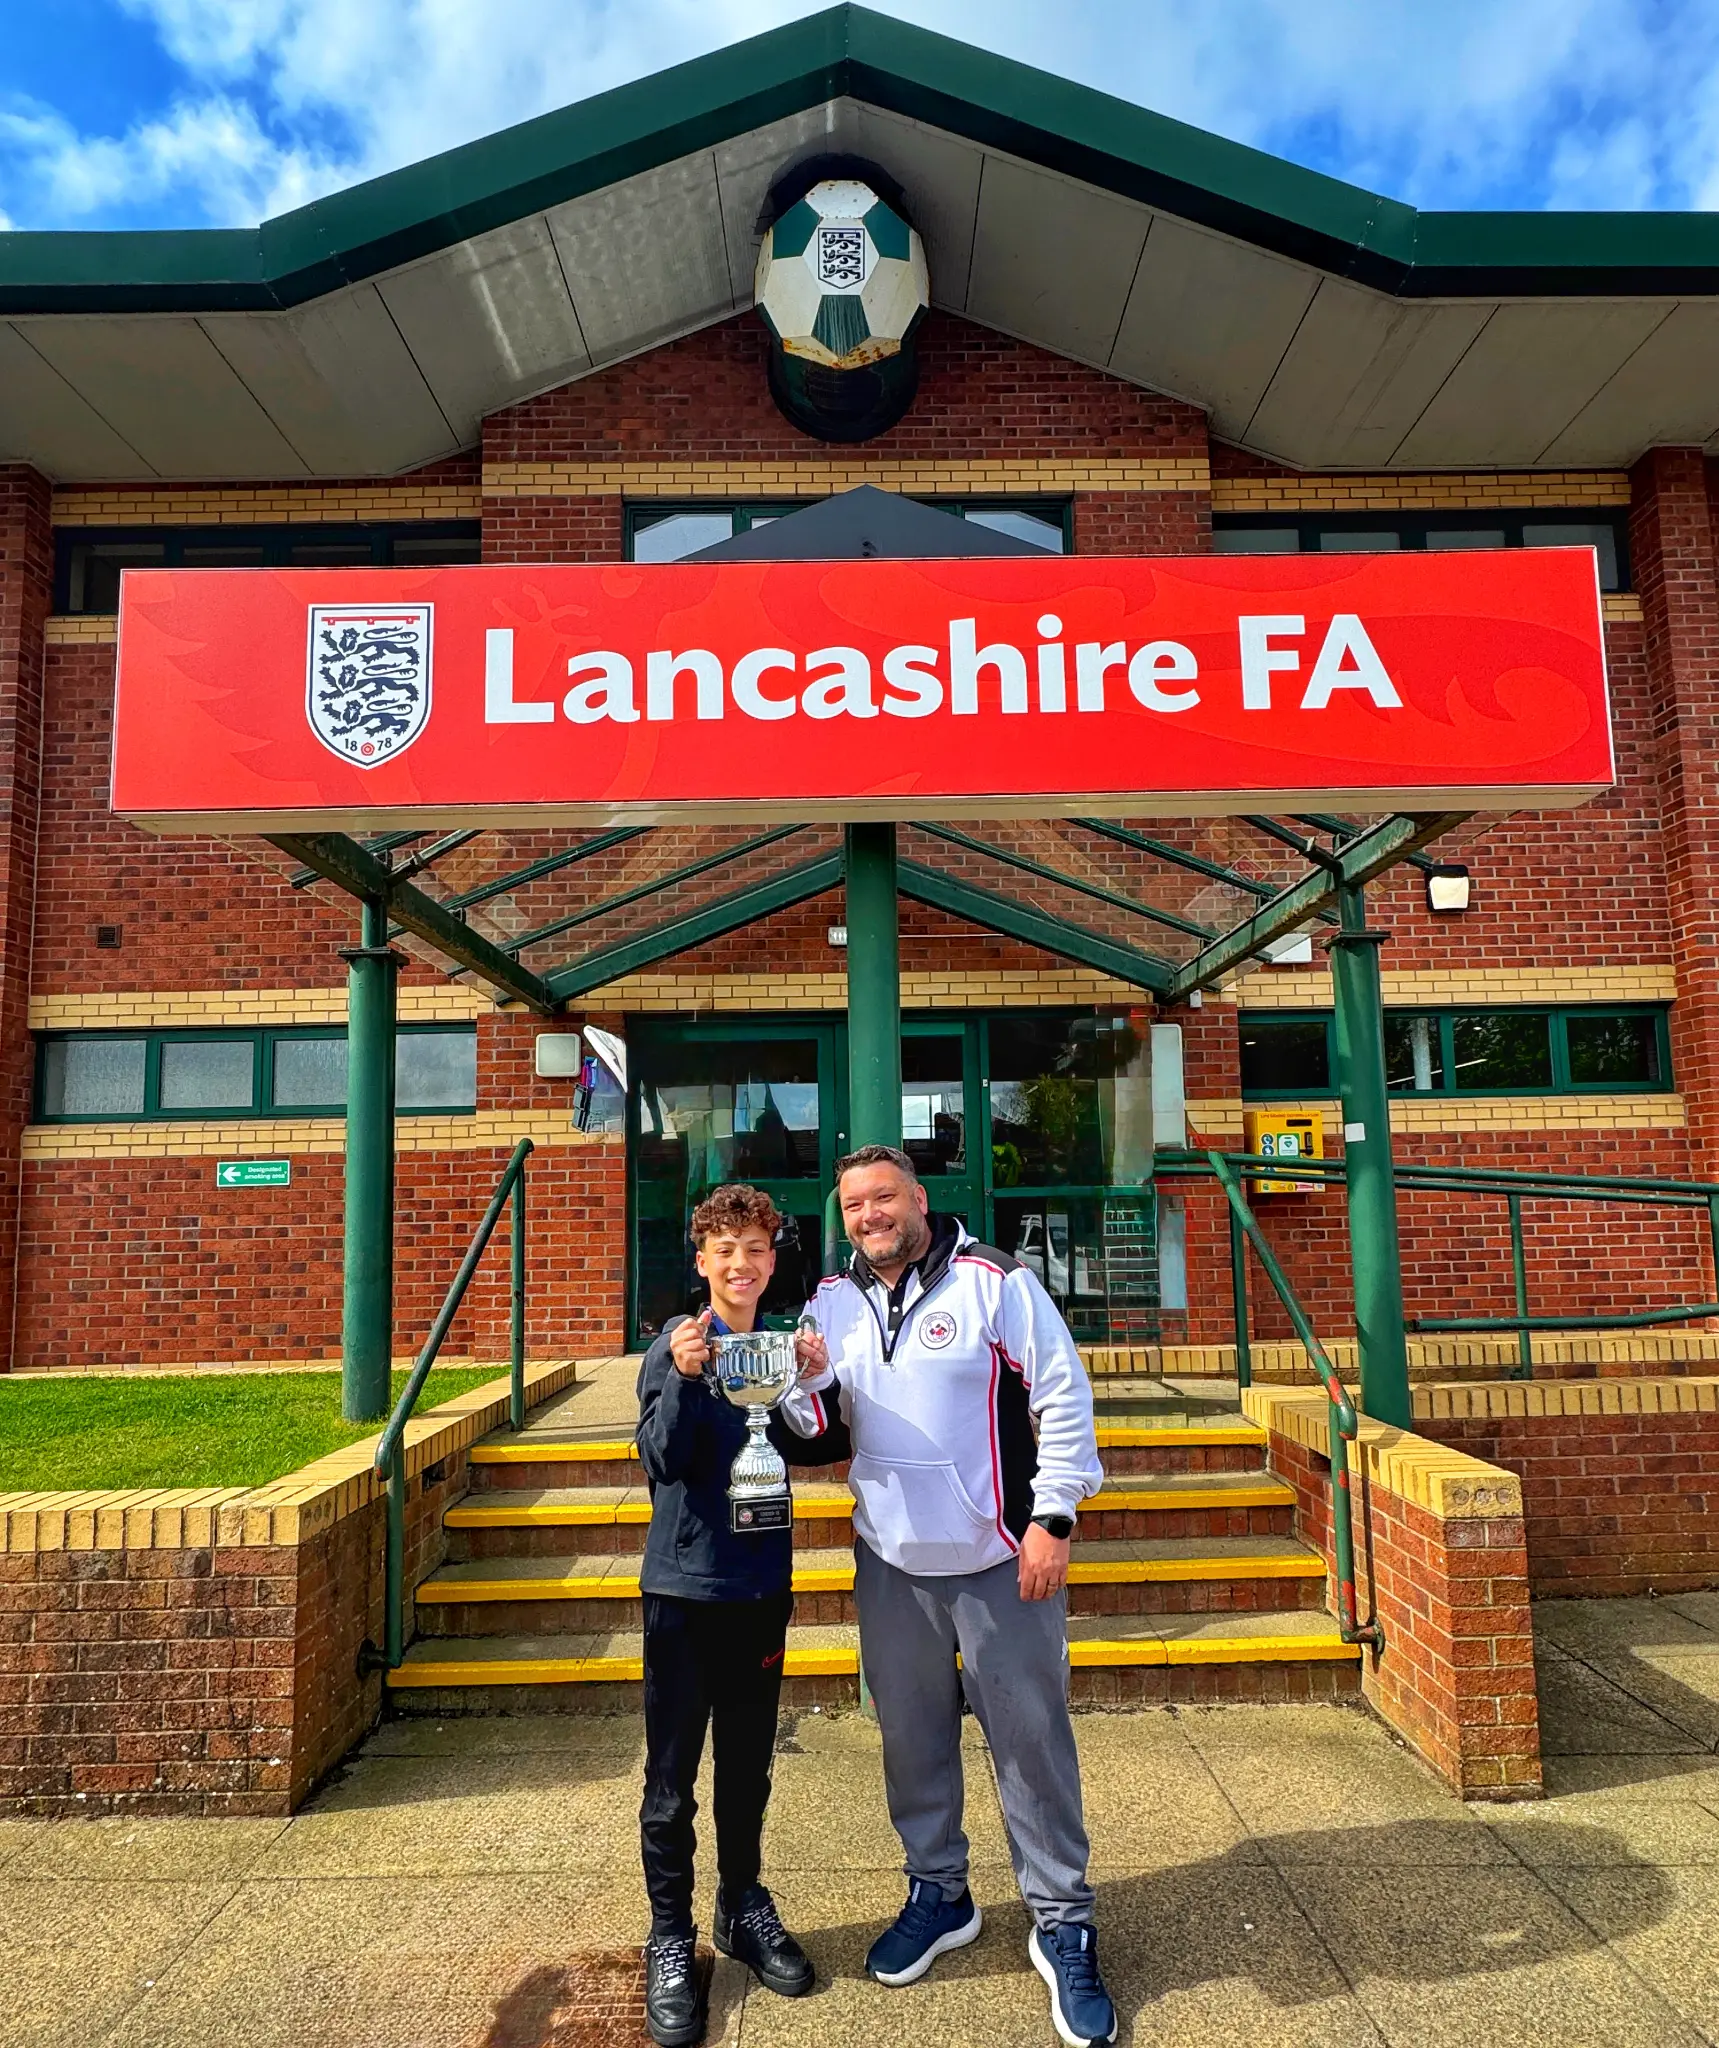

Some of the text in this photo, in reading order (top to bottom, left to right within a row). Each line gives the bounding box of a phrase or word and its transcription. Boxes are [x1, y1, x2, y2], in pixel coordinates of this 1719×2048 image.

[484, 614, 1404, 724] Lancashire FA
[345, 737, 393, 751] 18 78
